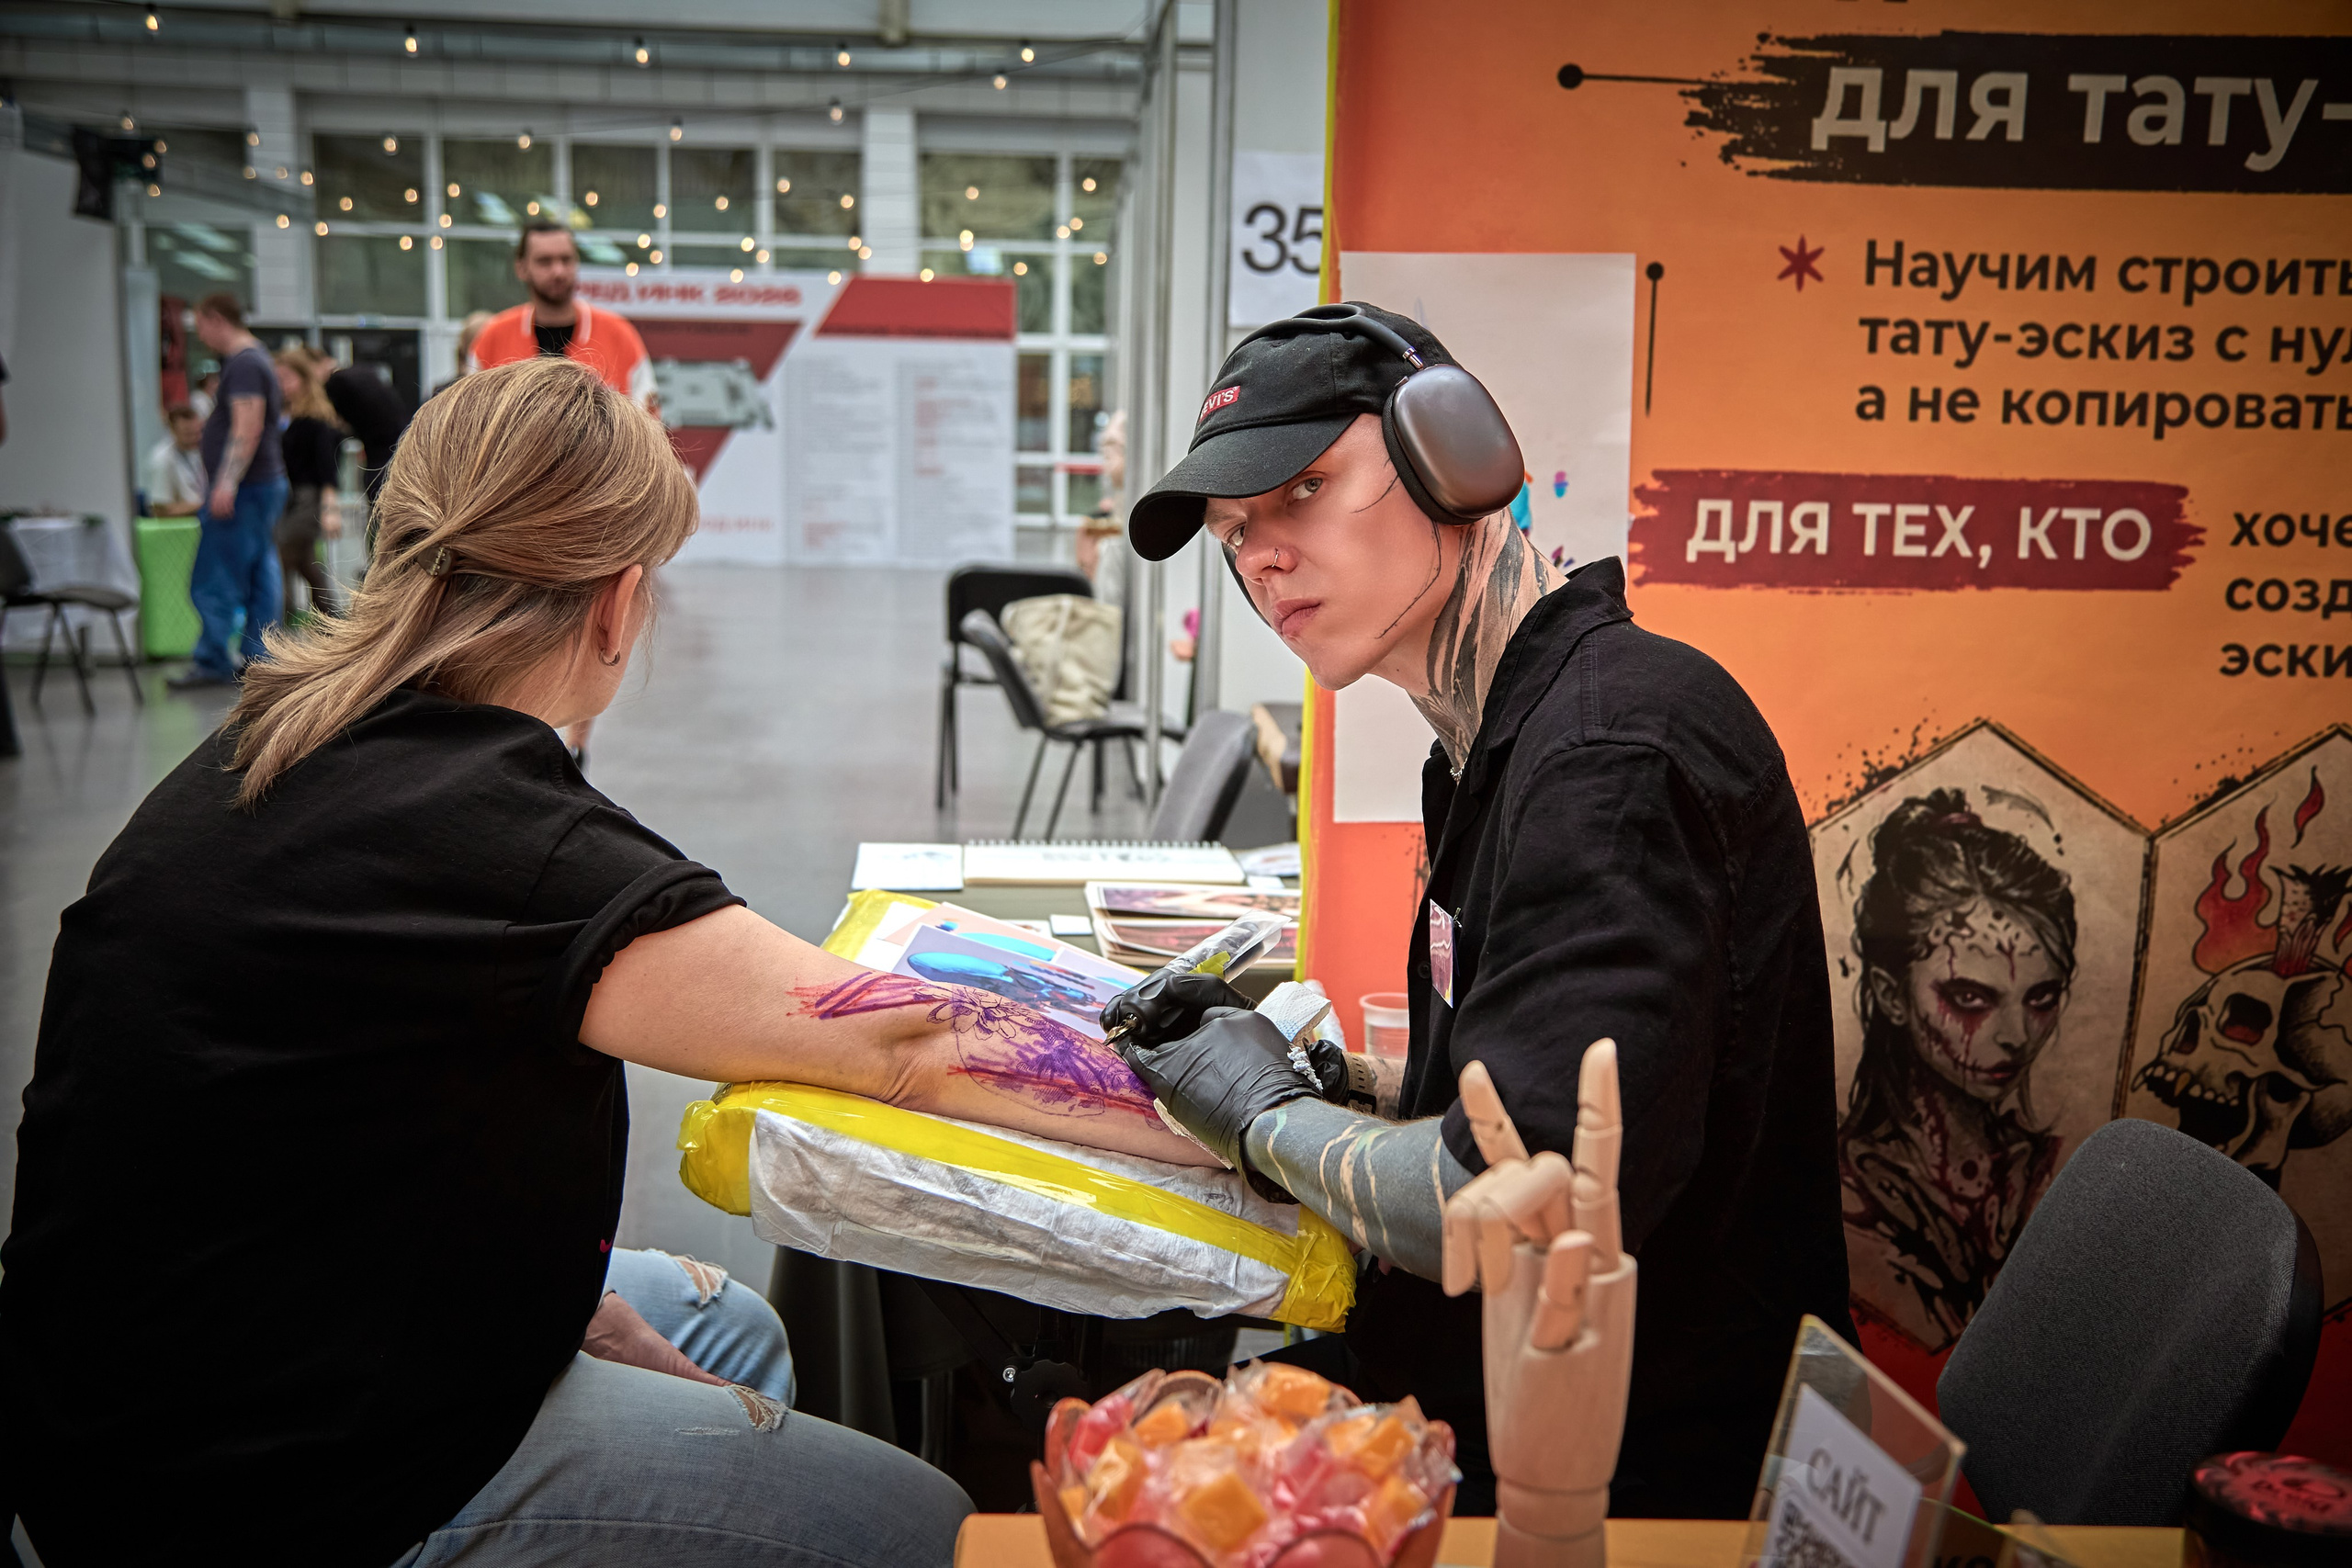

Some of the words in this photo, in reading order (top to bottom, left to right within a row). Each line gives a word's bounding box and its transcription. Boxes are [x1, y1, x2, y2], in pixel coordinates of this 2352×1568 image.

[1811, 65, 2030, 153] для
[2067, 73, 2352, 173] тату-
[1242, 202, 1324, 276] 35
[1864, 239, 2097, 301] Научим
[1859, 315, 2195, 369] тату-эскиз
[2215, 324, 2250, 364] с
[1855, 384, 1887, 423] а
[1908, 386, 1981, 425] не
[1686, 499, 1830, 563] ДЛЯ
[1852, 502, 1993, 569] ТЕХ,
[2017, 507, 2154, 562] КТО
[2229, 512, 2352, 548] хоче
[2225, 577, 2352, 620] созд
[2219, 643, 2352, 678] эски
[1805, 1446, 1885, 1547] САЙТ
